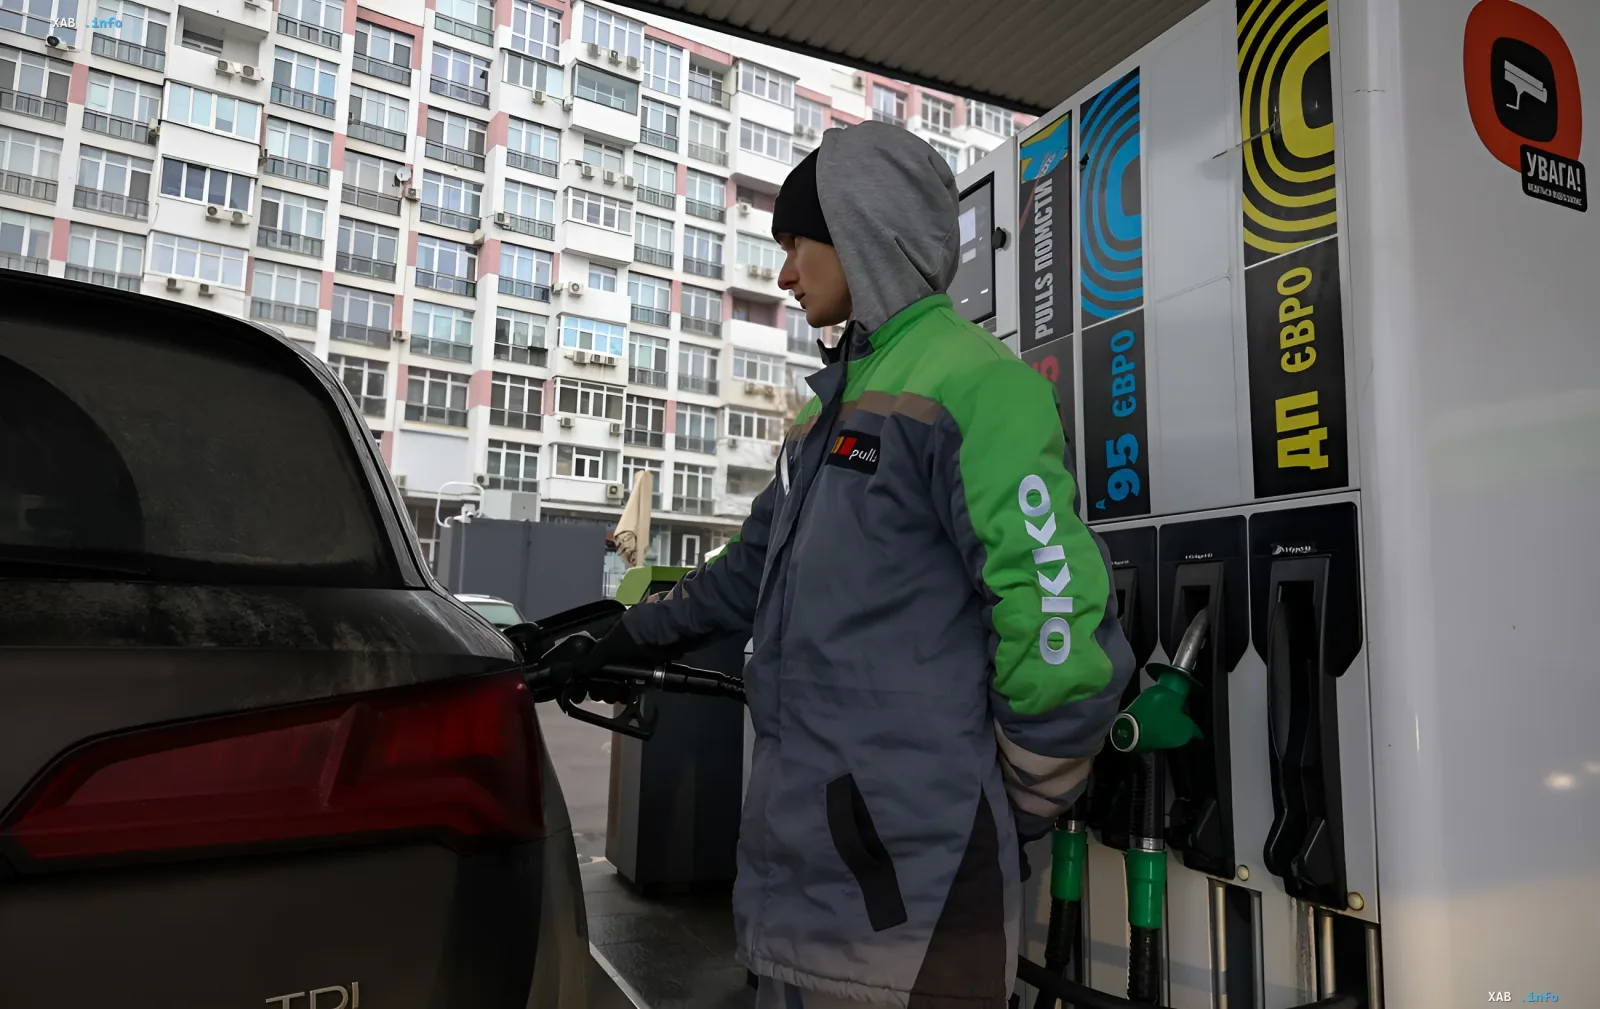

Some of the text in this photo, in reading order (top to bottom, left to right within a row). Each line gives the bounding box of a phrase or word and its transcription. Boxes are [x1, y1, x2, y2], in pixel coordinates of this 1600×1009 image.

[1526, 151, 1581, 192] УВАГА!
[1034, 178, 1054, 340] PULLS ПОМСТИ
[1110, 329, 1137, 418] ЄВРО
[1275, 266, 1329, 471] ДП ЄВРО
[1105, 433, 1141, 502] 95
[1018, 474, 1073, 665] OKKO
